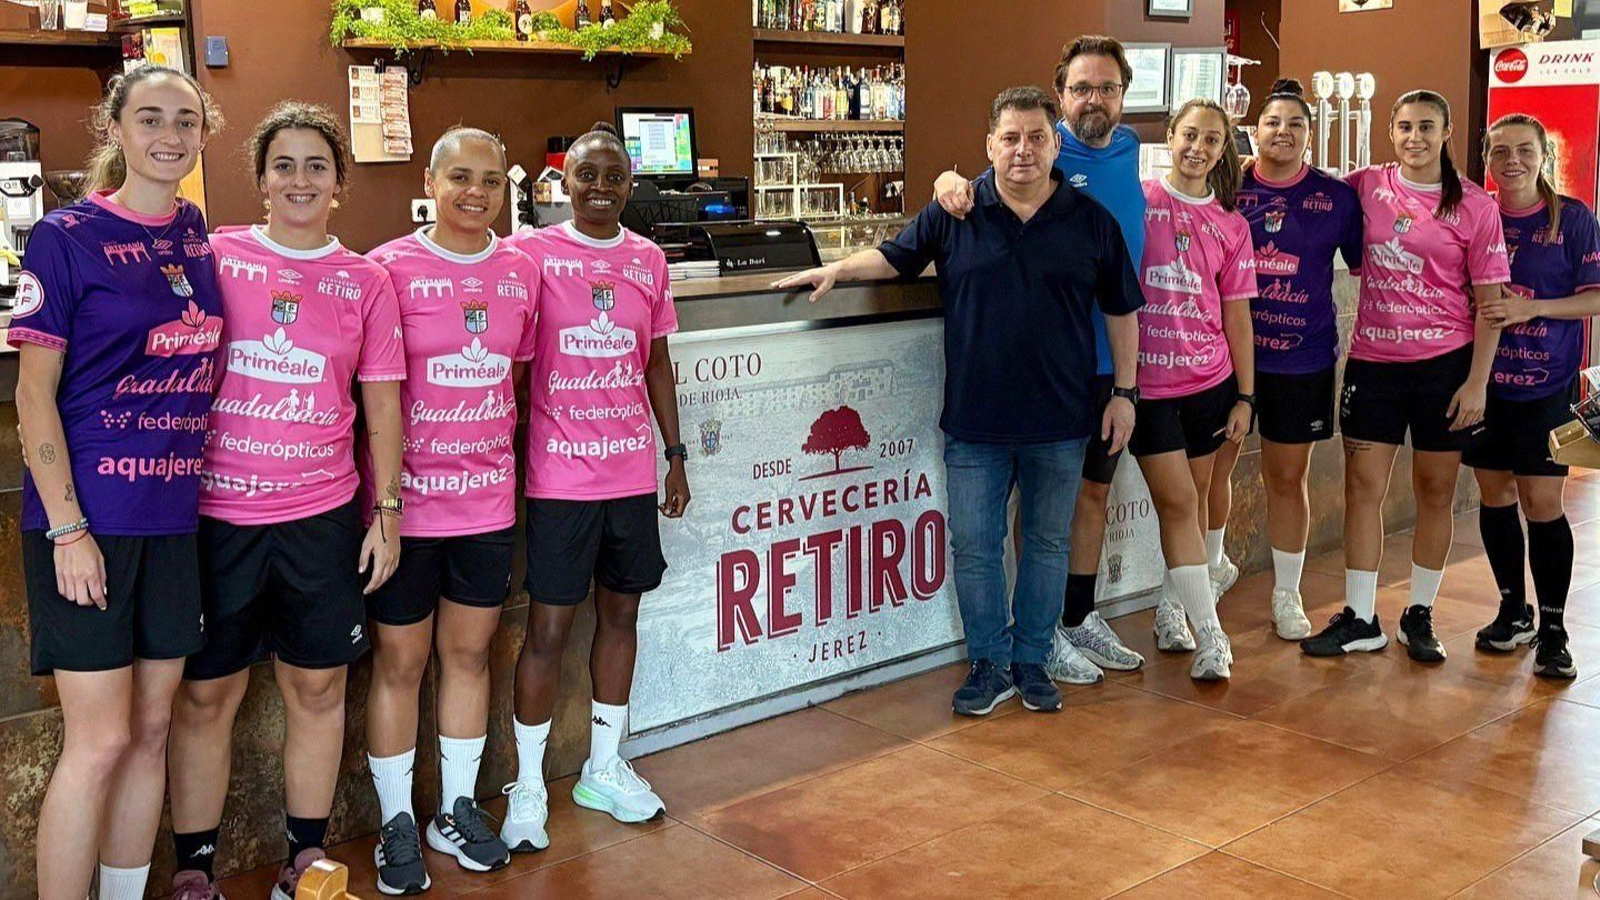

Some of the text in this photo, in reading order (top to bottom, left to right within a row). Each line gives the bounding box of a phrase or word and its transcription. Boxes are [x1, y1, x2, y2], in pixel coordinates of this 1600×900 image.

[1539, 53, 1594, 64] DRINK
[623, 268, 653, 285] RETIRO
[317, 280, 361, 301] RETIRO
[497, 284, 528, 300] RETIRO
[564, 333, 633, 351] Priméale
[229, 348, 320, 379] Priméale
[432, 361, 505, 380] Priméale
[673, 352, 761, 386] L COTO
[679, 387, 741, 407] DE RIOJA
[219, 431, 334, 461] federópticos
[546, 436, 646, 460] aquajerez
[753, 439, 914, 480] DESDE 2007
[98, 452, 204, 482] aquajere
[401, 468, 507, 495] aquajerez
[732, 469, 932, 534] CERVECERÍA
[1105, 498, 1150, 526] COTO
[1109, 527, 1134, 543] RIOJA
[717, 509, 946, 652] RETIRO
[808, 631, 868, 663] JEREZ
